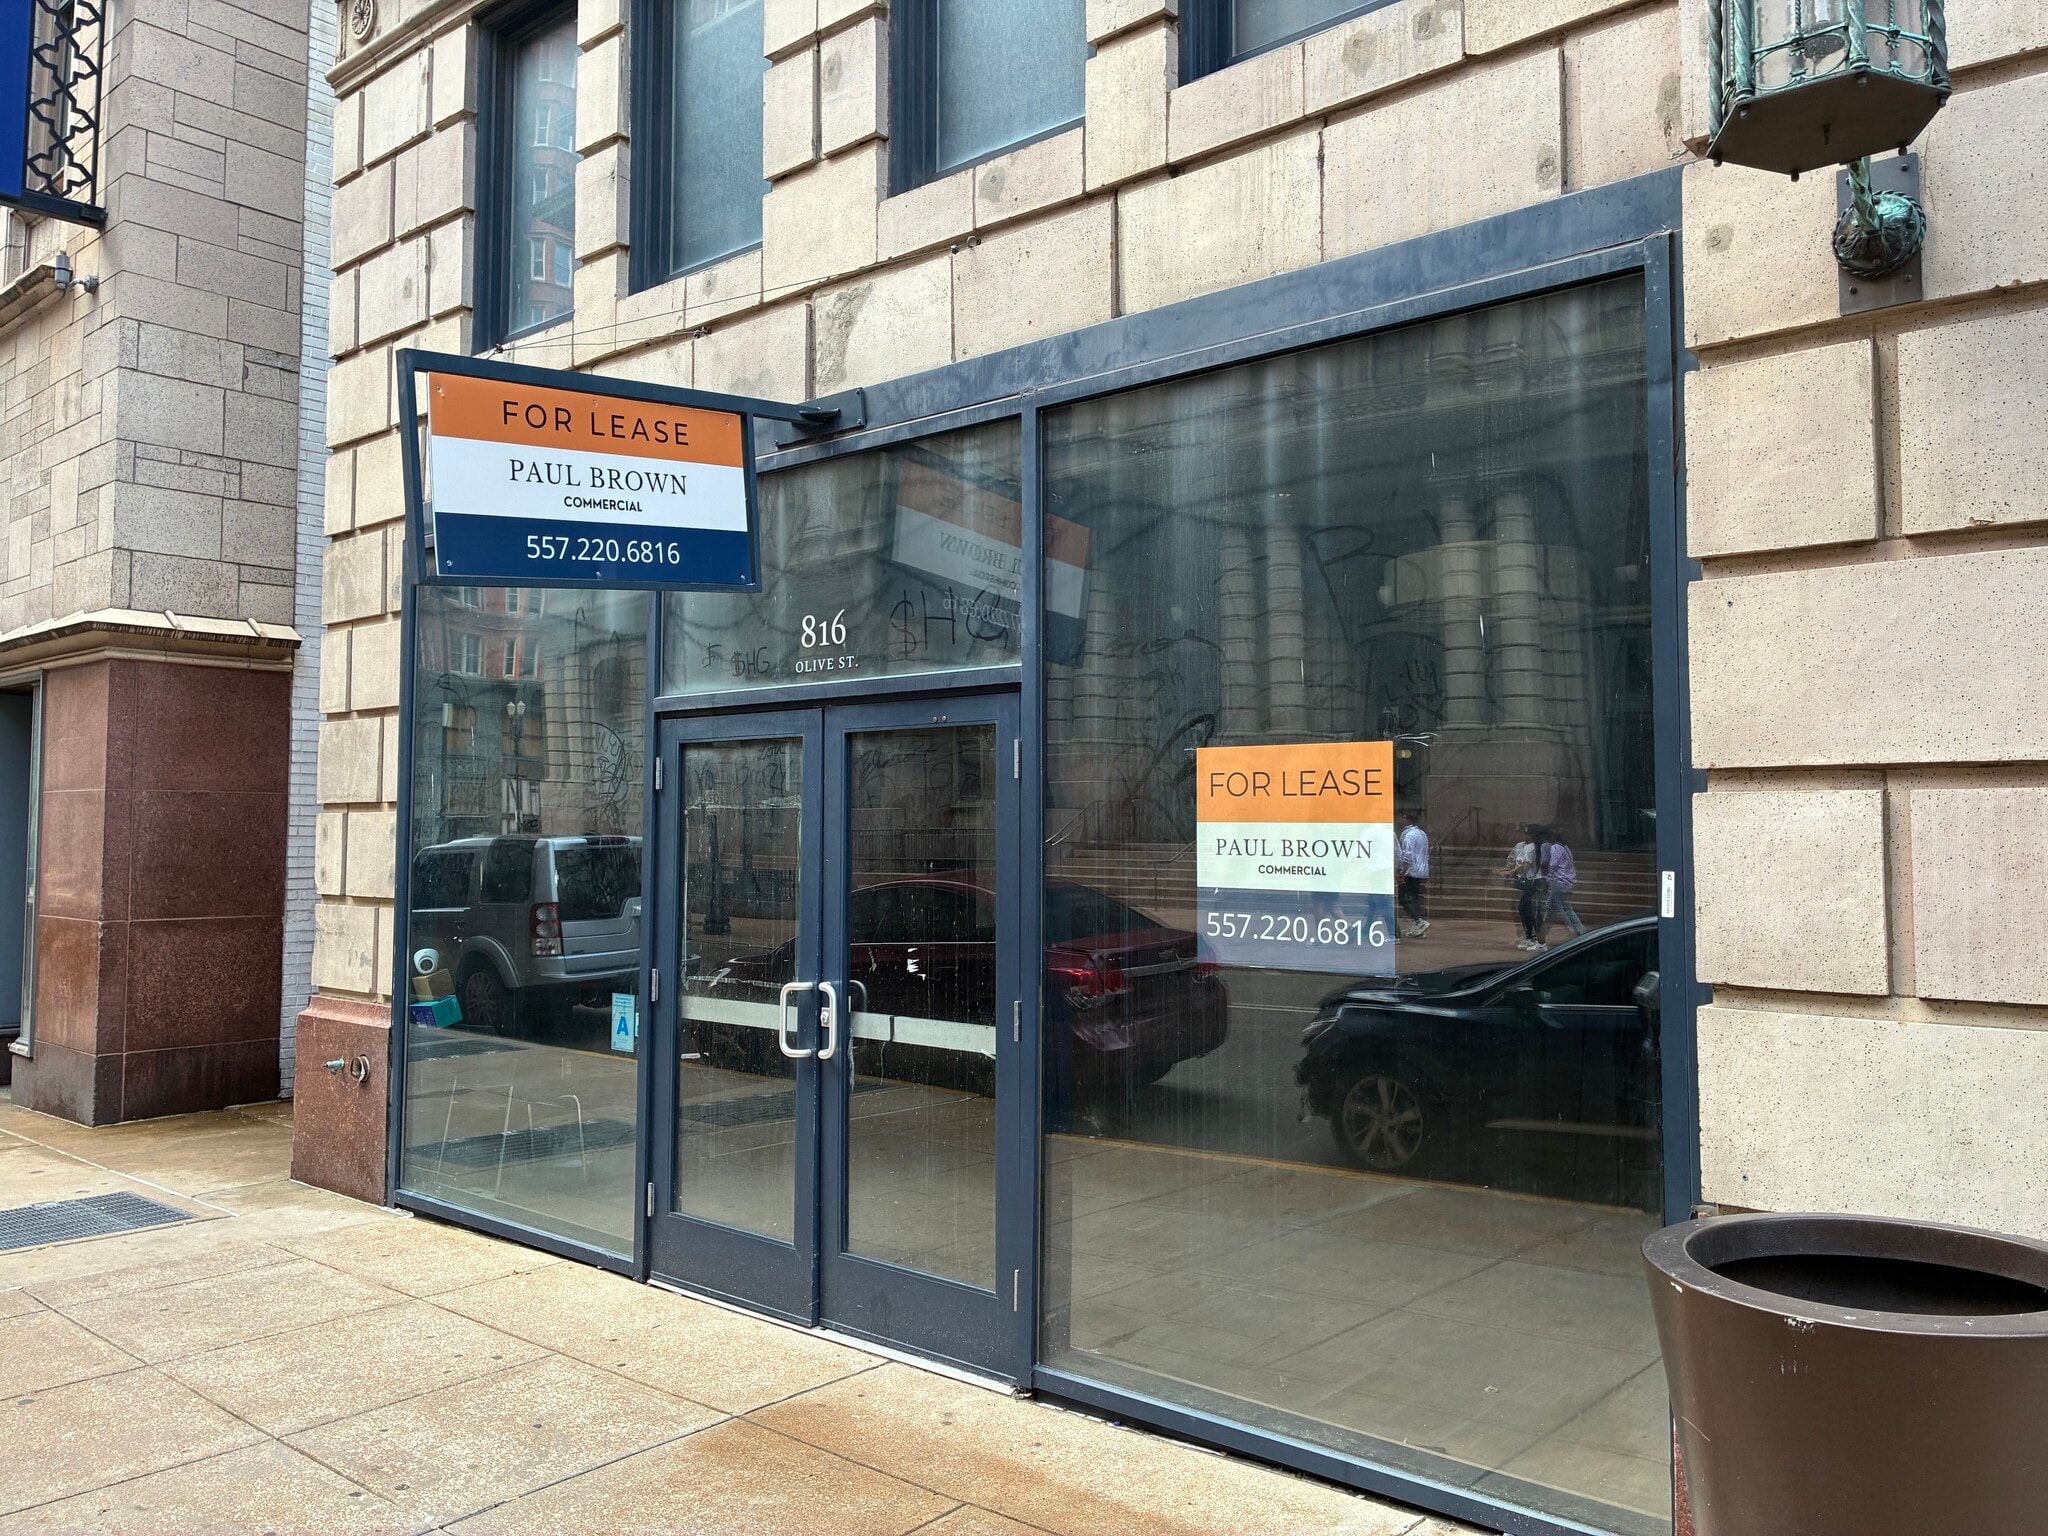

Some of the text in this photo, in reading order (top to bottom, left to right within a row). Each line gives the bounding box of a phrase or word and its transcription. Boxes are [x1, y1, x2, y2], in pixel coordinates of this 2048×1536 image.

[502, 400, 690, 446] FOR LEASE
[509, 459, 688, 495] PAUL BROWN
[563, 496, 643, 512] COMMERCIAL
[526, 534, 681, 565] 557.220.6816
[801, 608, 847, 648] 816
[795, 655, 859, 674] OLIVE ST.
[1209, 769, 1383, 797] FOR LEASE
[1215, 838, 1373, 859] PAUL BROWN
[1258, 864, 1327, 876] COMMERCIAL
[1206, 912, 1386, 948] 557.220.6816
[616, 1015, 629, 1036] A
